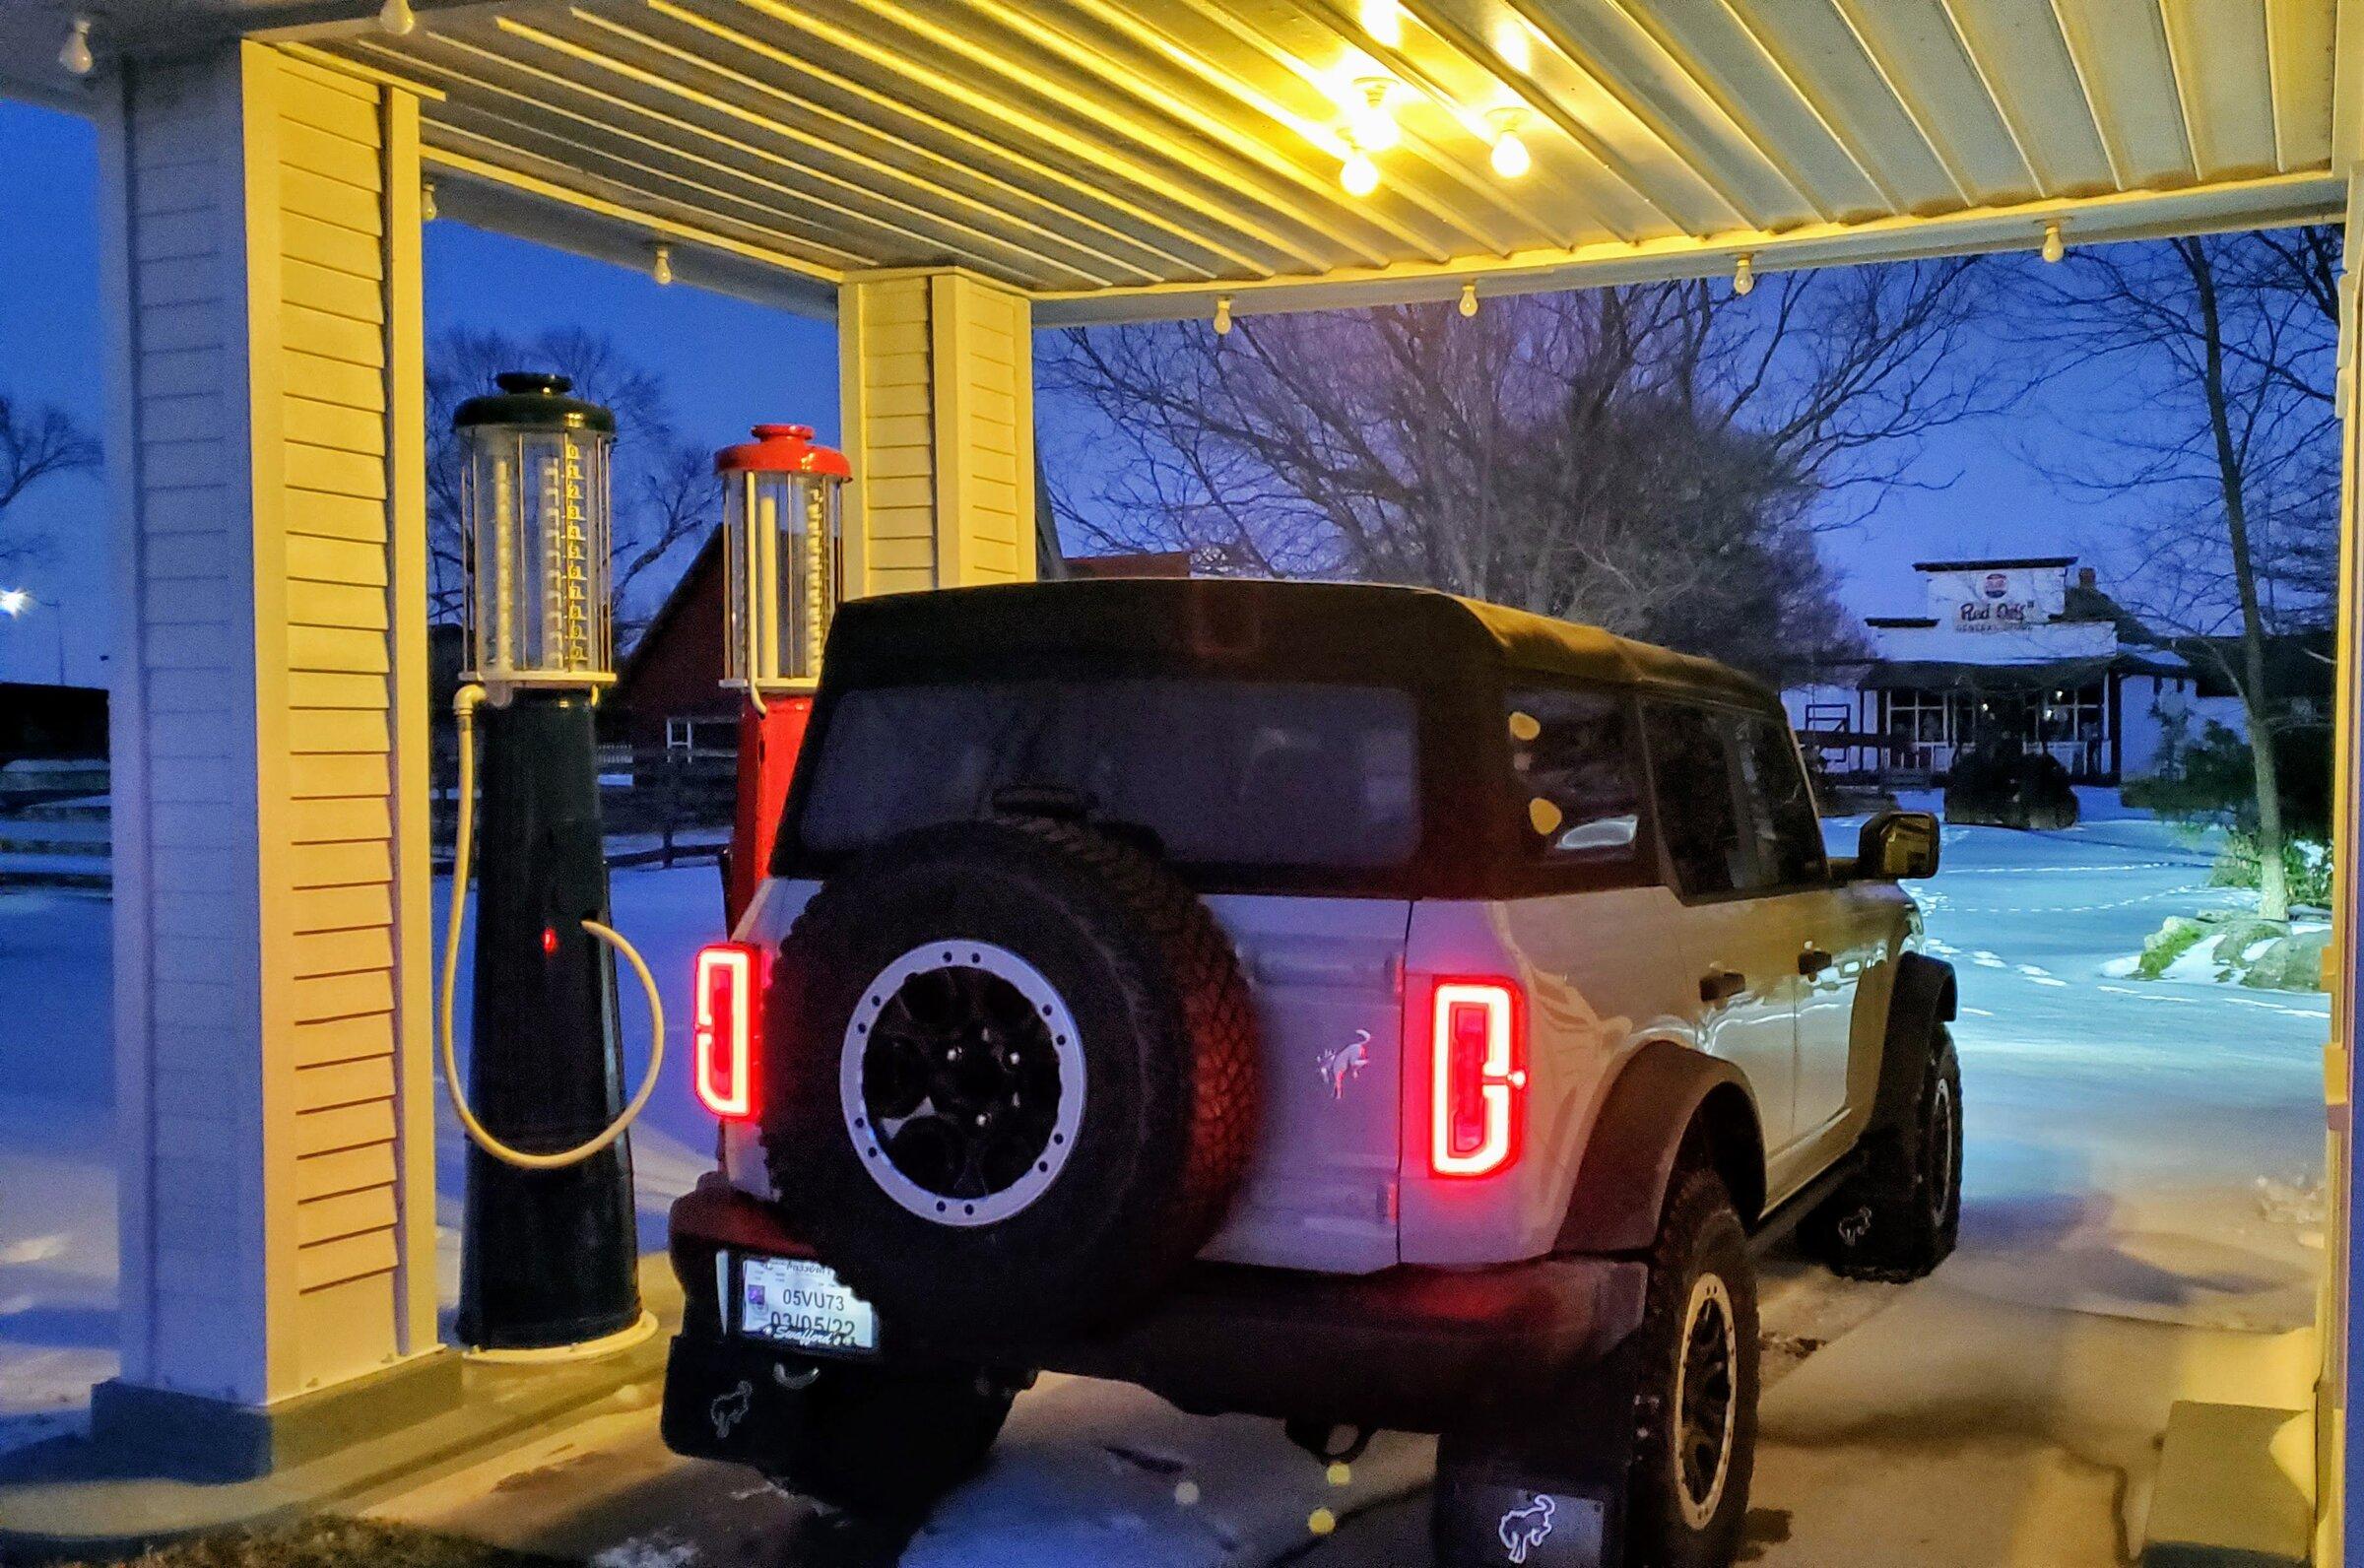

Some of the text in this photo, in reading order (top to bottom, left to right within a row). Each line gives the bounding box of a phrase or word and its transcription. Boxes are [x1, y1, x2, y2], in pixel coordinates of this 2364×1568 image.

[1960, 602, 1991, 621] Red
[783, 1288, 844, 1311] 05VU73
[770, 1311, 856, 1338] 03/05/22
